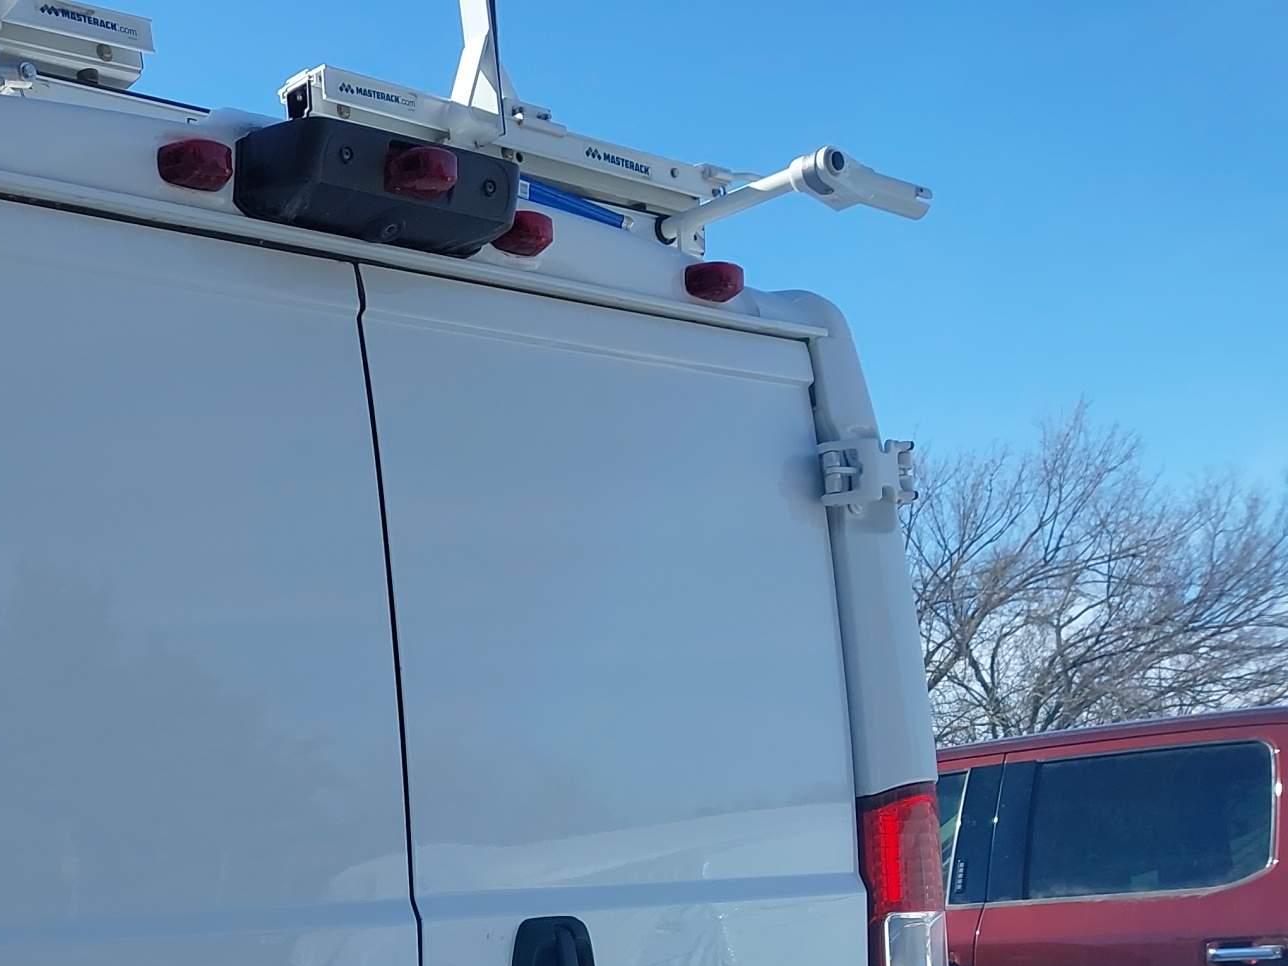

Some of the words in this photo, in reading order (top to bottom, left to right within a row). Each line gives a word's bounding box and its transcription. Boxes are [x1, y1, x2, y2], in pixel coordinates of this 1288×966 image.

[60, 8, 138, 36] MASTERACK.com
[355, 86, 416, 108] MASTERACK.com
[603, 152, 650, 176] MASTERACK
